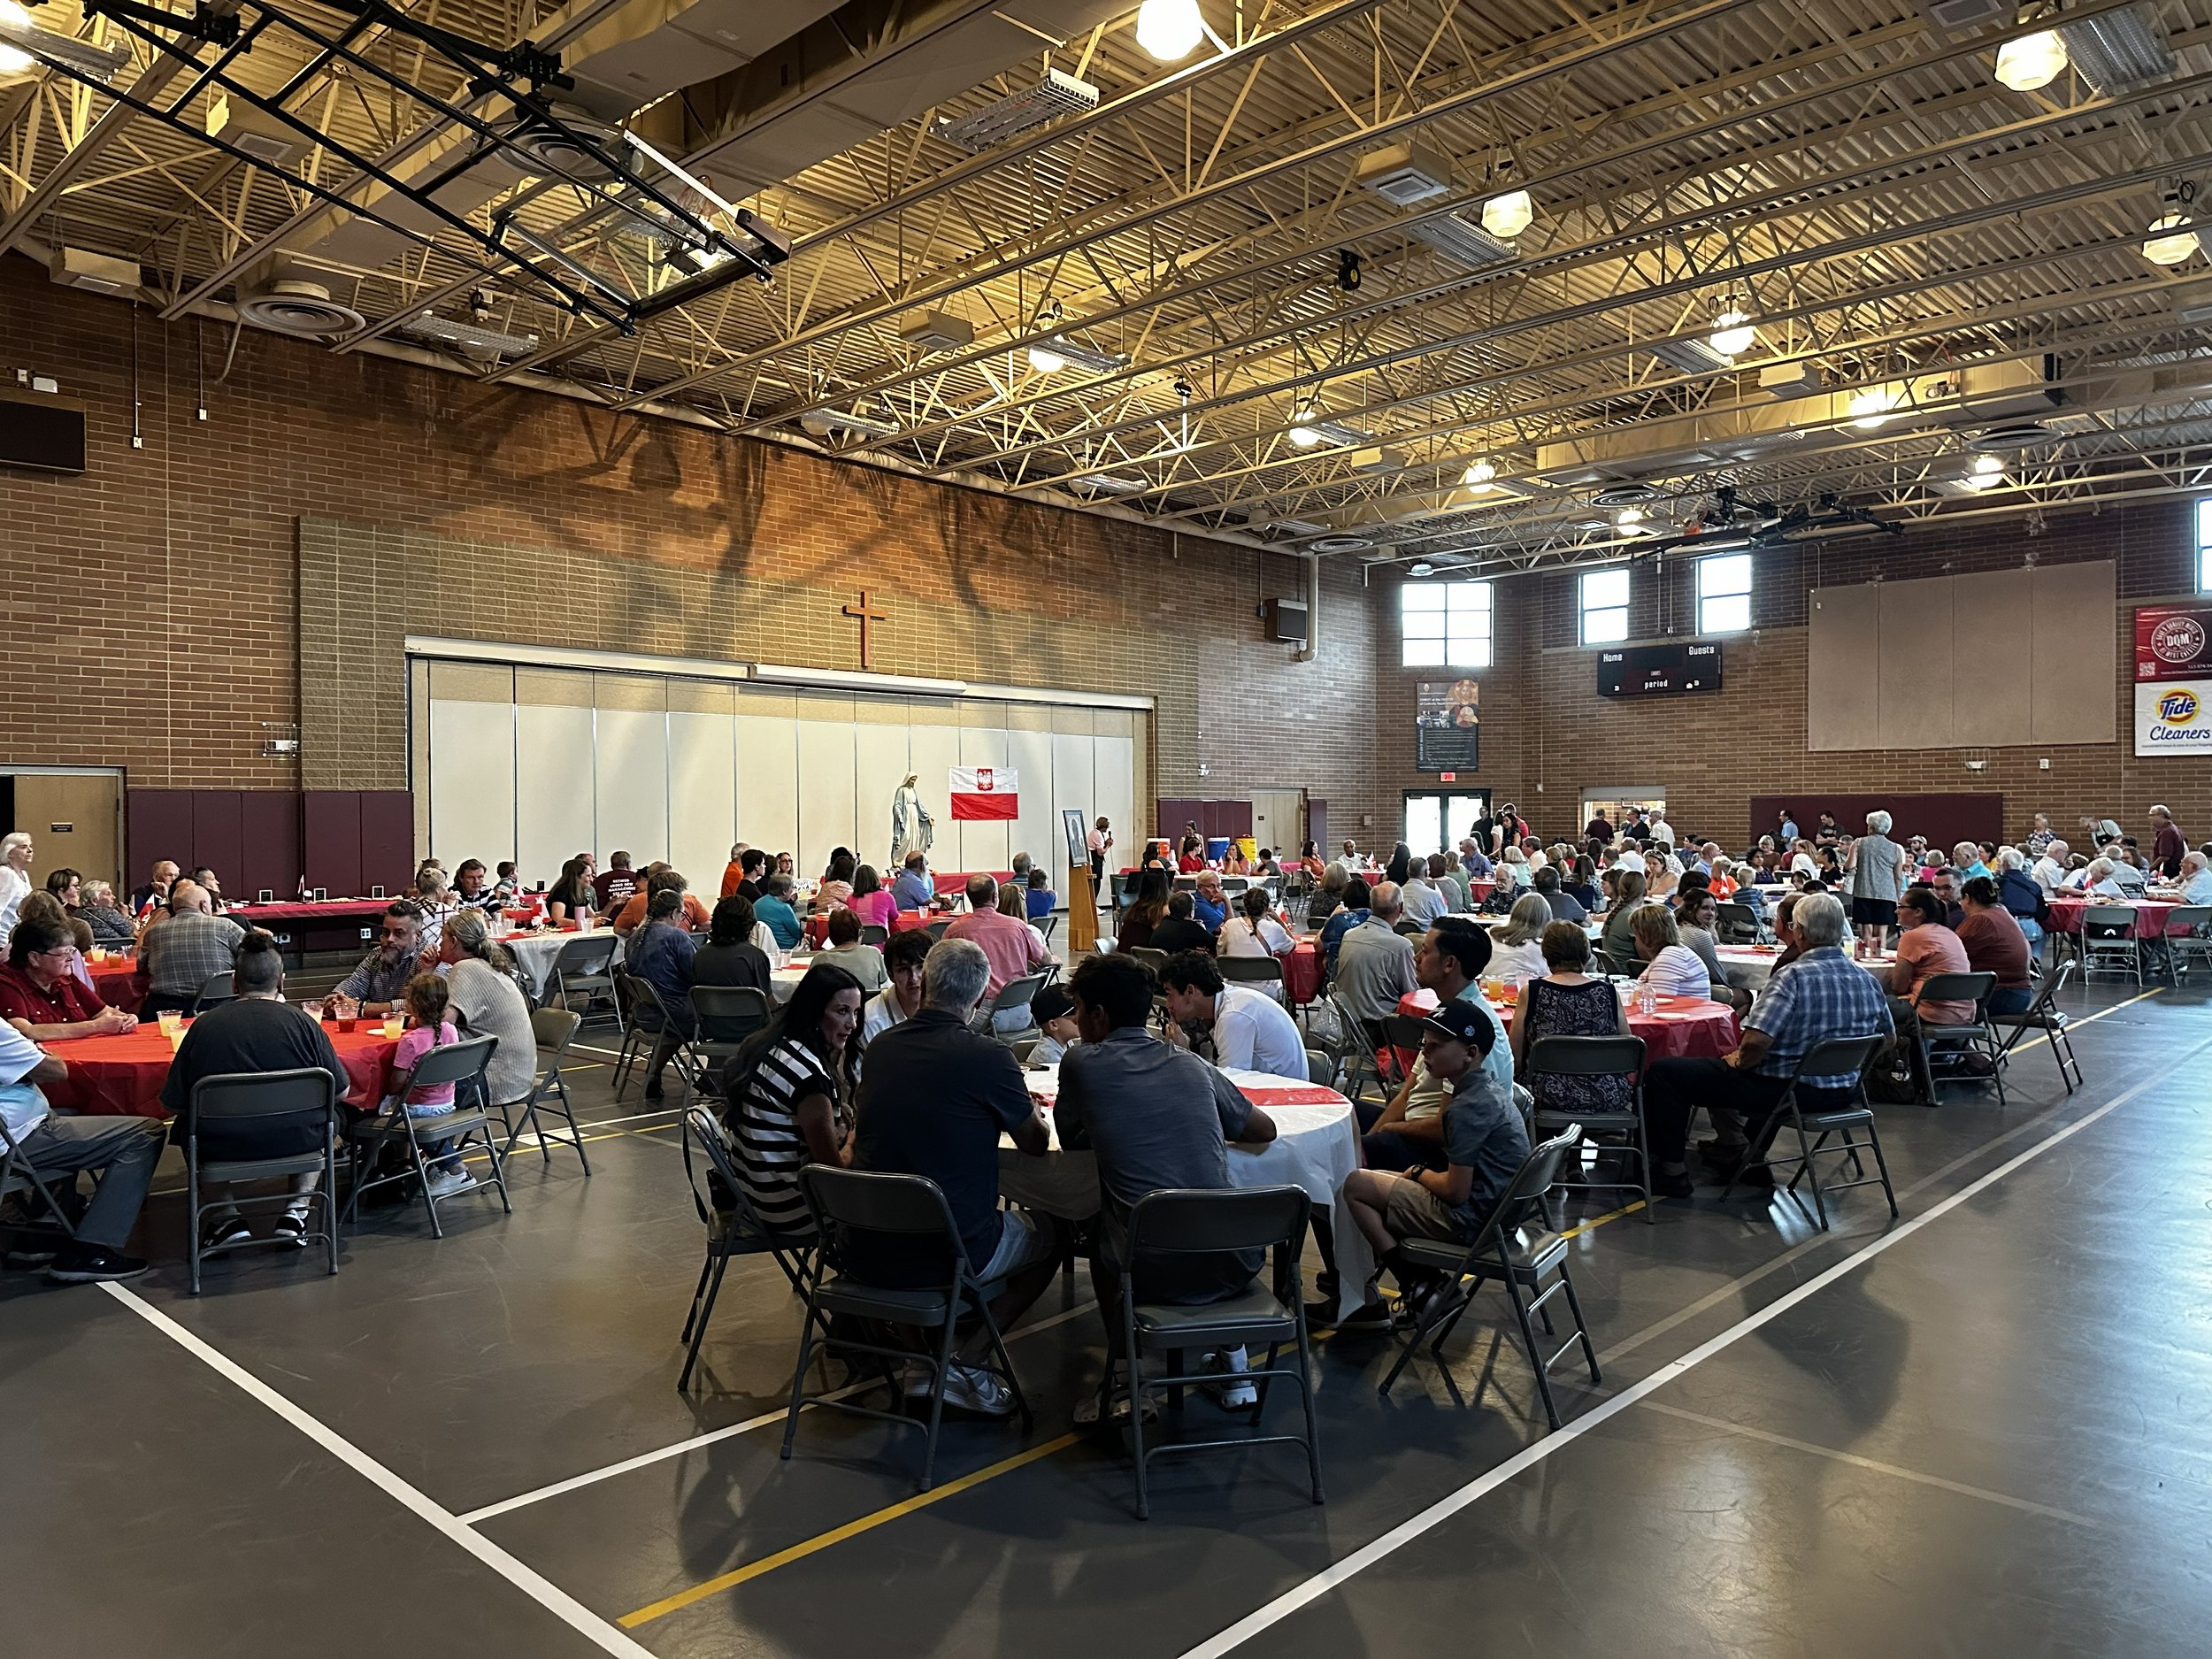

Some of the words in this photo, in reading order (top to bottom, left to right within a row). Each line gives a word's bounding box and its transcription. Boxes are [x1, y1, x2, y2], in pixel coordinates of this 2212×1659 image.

[2166, 633, 2190, 647] DQM
[1688, 646, 1715, 656] Guests
[1602, 653, 1623, 663] Home
[1644, 680, 1668, 690] period
[2160, 697, 2197, 719] Tide
[2150, 726, 2211, 741] Cleaners
